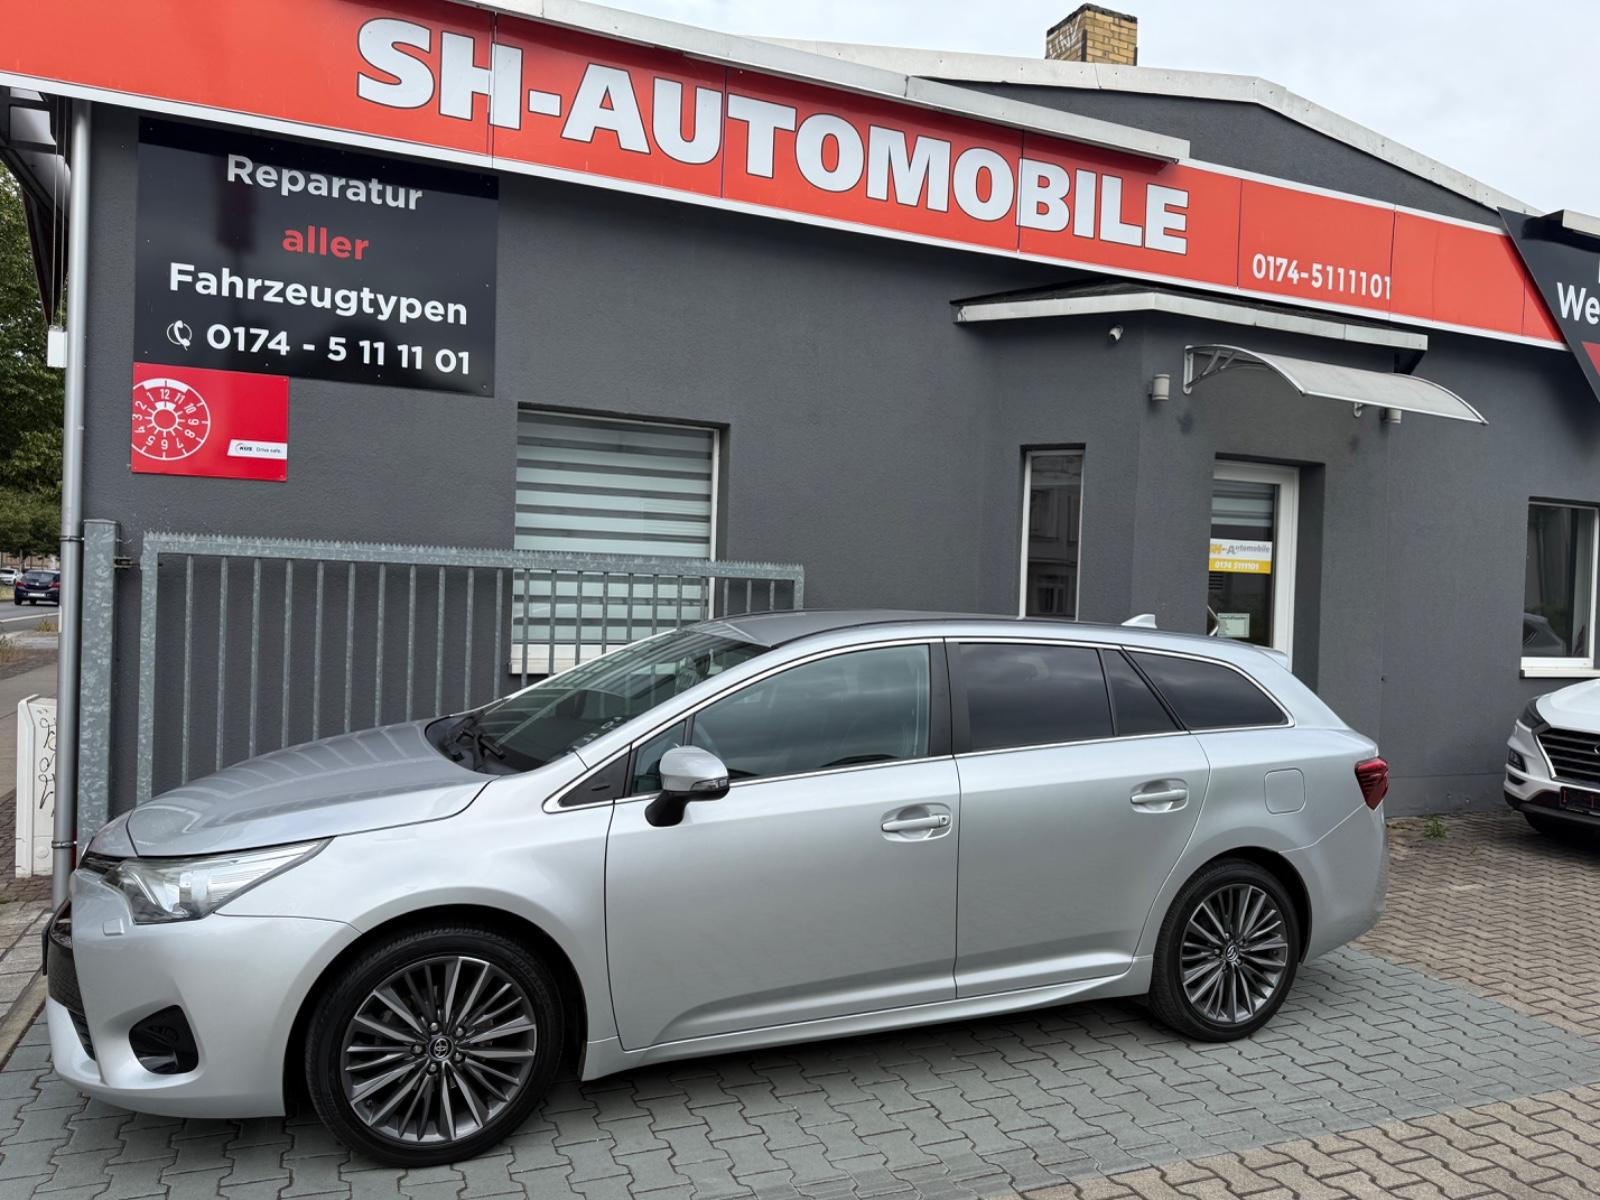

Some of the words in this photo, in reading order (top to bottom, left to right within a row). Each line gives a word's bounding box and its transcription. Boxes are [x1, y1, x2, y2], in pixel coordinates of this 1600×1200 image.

[357, 17, 1190, 255] SH-AUTOMOBILE
[226, 153, 424, 212] Reparatur
[282, 226, 370, 260] aller
[1251, 253, 1392, 301] 0174-5111101
[168, 260, 468, 326] Fahrzeugtypen
[206, 323, 291, 356] 0174
[327, 336, 347, 362] 5
[358, 339, 385, 366] 11
[397, 343, 423, 370] 11
[434, 348, 470, 375] 01
[146, 391, 155, 402] 1
[159, 388, 170, 400] 12
[174, 392, 186, 405] 11
[135, 400, 148, 411] 2
[183, 403, 197, 414] 10
[132, 413, 143, 421] 3
[187, 418, 200, 426] 9
[134, 426, 146, 434] 4
[184, 429, 196, 439] 8
[145, 435, 156, 446] 5
[160, 439, 168, 450] 6
[175, 437, 184, 449] 7
